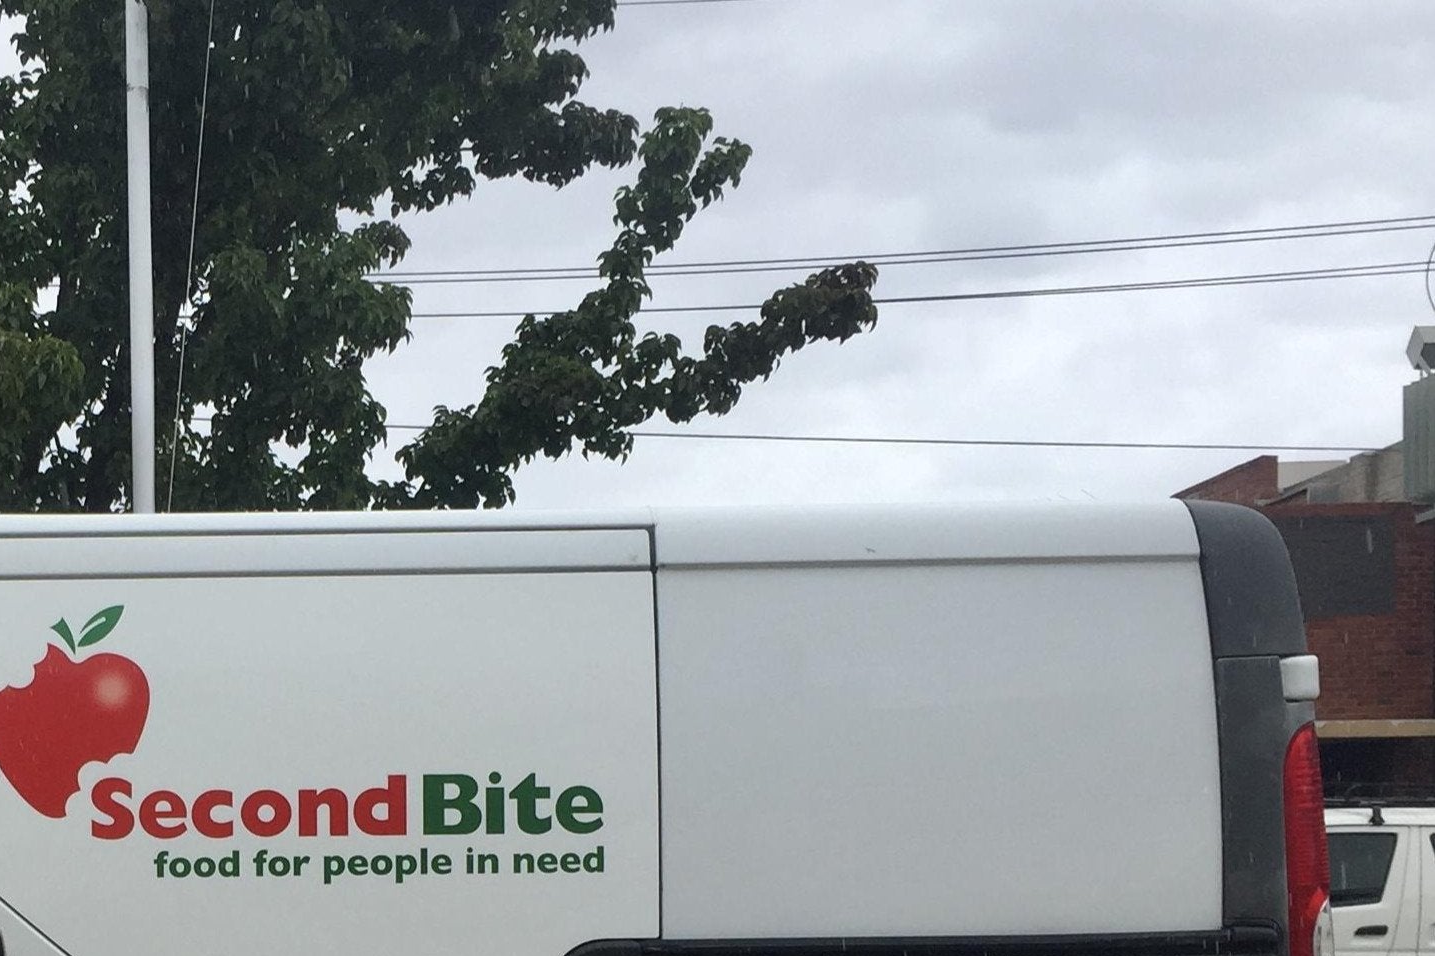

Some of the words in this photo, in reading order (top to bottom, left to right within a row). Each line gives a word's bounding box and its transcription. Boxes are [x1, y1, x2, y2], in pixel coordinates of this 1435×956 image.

[153, 849, 241, 879] food
[252, 849, 311, 878] for
[323, 847, 453, 885] people
[466, 846, 499, 875] in
[513, 845, 605, 874] need
